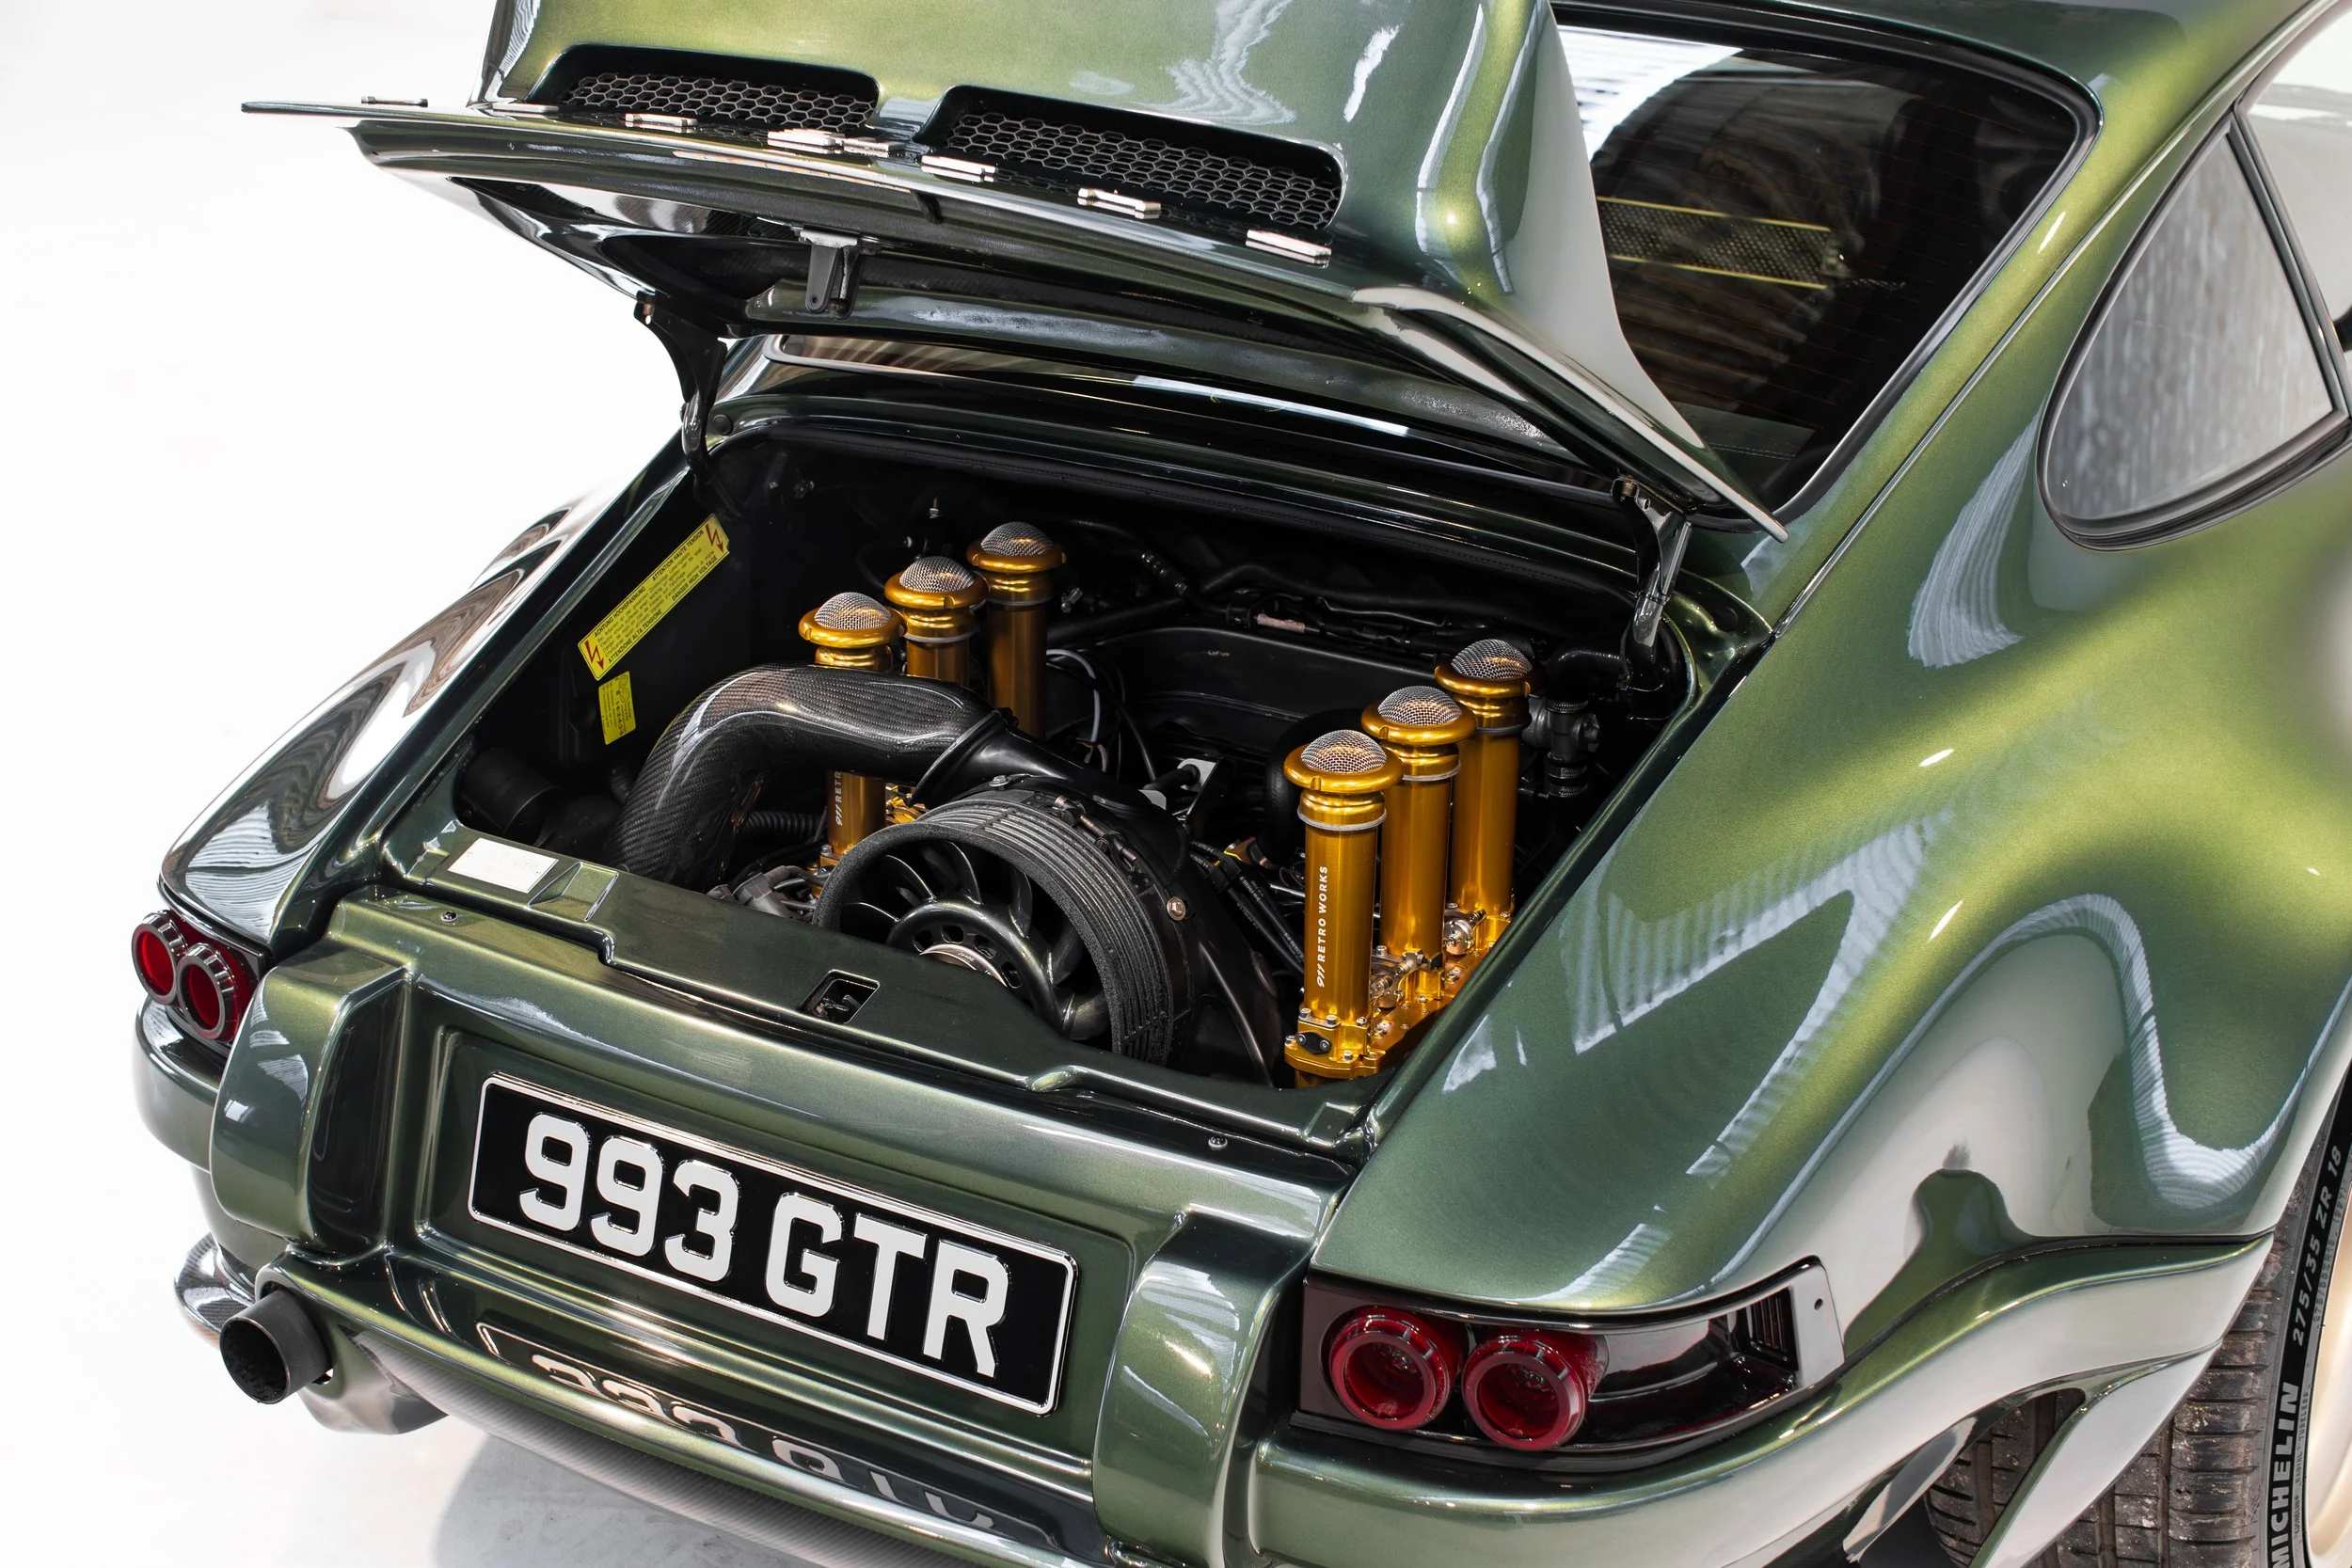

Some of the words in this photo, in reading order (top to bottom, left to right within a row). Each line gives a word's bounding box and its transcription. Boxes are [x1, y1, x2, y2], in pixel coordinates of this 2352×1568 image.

[651, 558, 674, 580] ATTENTION
[673, 545, 687, 561] HAUTE
[686, 528, 704, 547] TENSION
[671, 582, 689, 601] DANGER
[688, 572, 699, 585] HIGH
[698, 554, 717, 575] VOLTAGE
[594, 615, 613, 637] ACHTUNG
[608, 638, 632, 663] ATTENZIONE
[631, 627, 643, 640] ALTA
[643, 608, 662, 629] TENSIONE
[1318, 865, 1328, 913] WORKS
[1317, 917, 1327, 962] RETRO
[518, 1113, 740, 1282] 993
[765, 1191, 1011, 1378] GTR
[2293, 1234, 2321, 1346] 275/35
[2315, 1185, 2332, 1229] ZR
[2328, 1146, 2342, 1176] 18
[2271, 1382, 2299, 1568] MICHELIN
